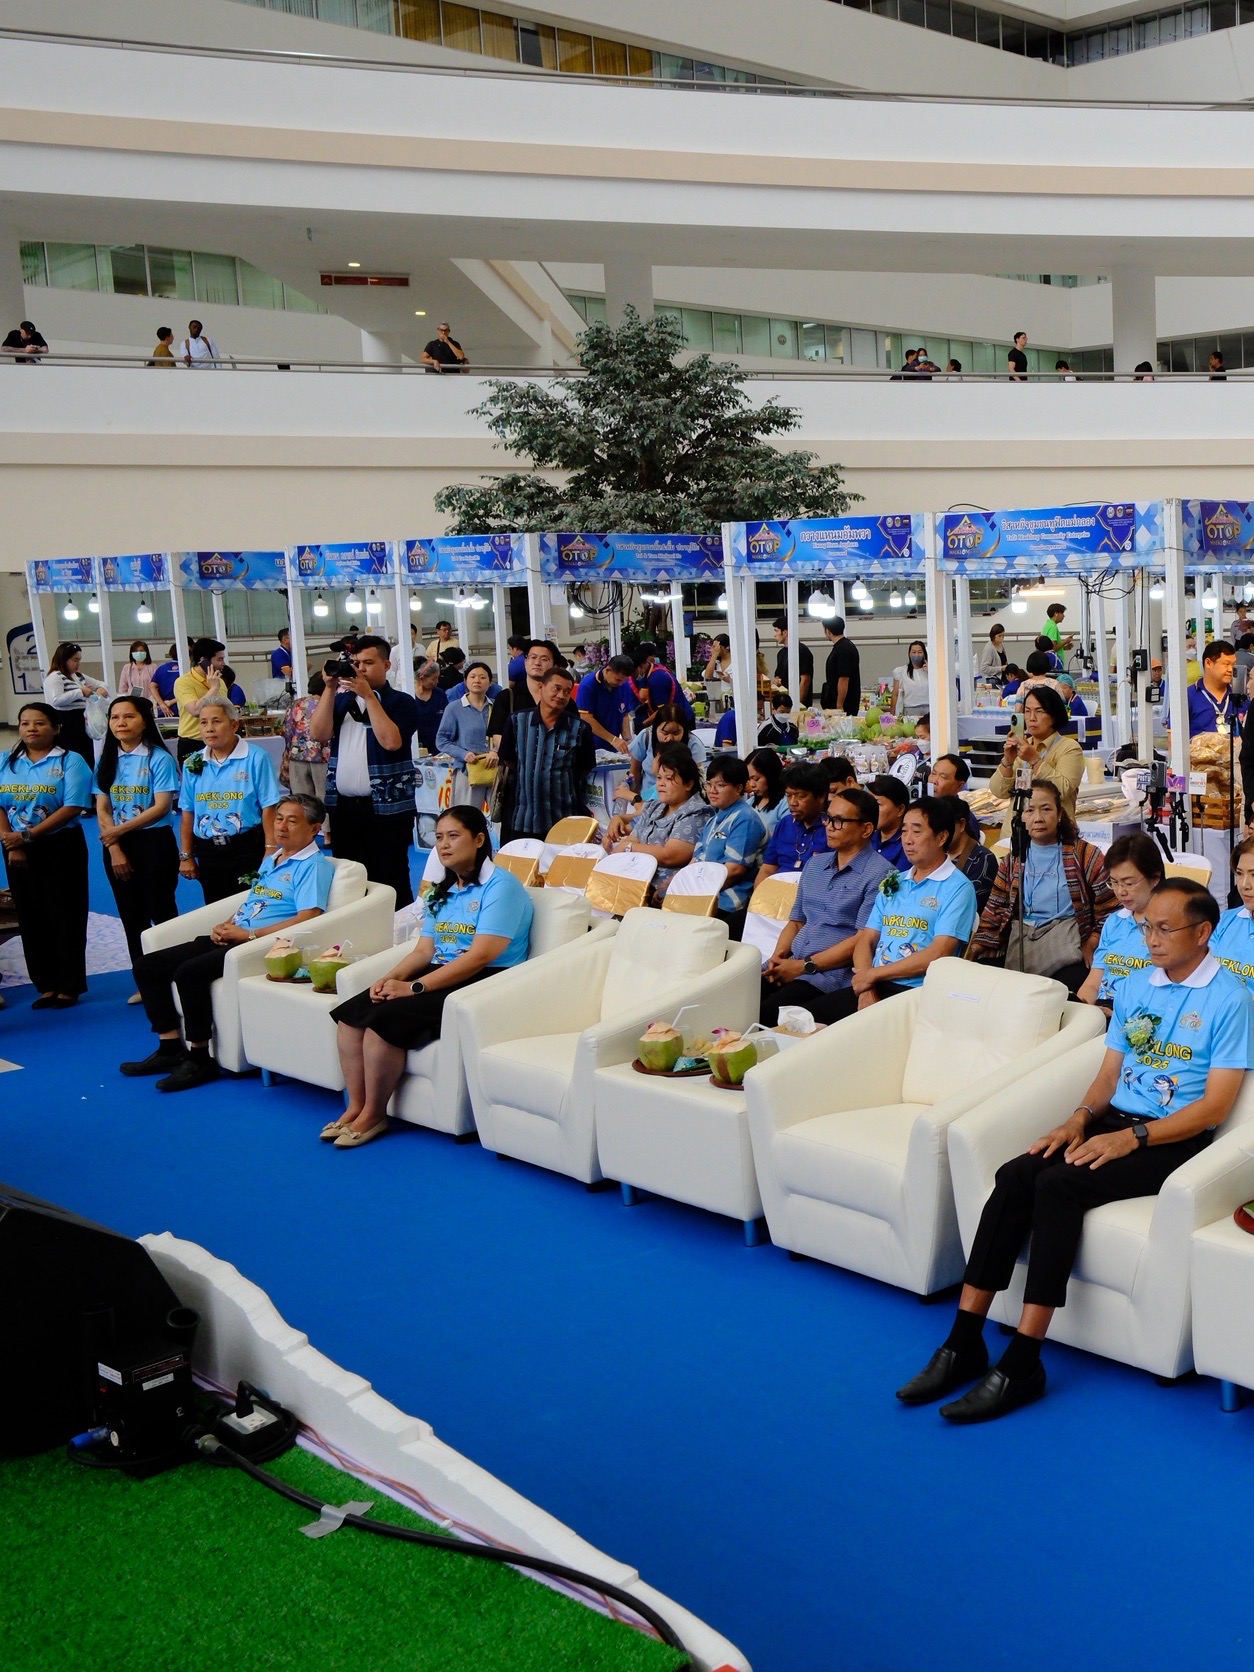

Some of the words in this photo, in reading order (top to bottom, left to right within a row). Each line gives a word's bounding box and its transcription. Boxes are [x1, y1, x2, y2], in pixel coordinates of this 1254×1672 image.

[1207, 524, 1241, 539] OTOP
[750, 540, 780, 553] OTOP
[947, 534, 983, 549] OTOP
[562, 550, 598, 561] OTOP
